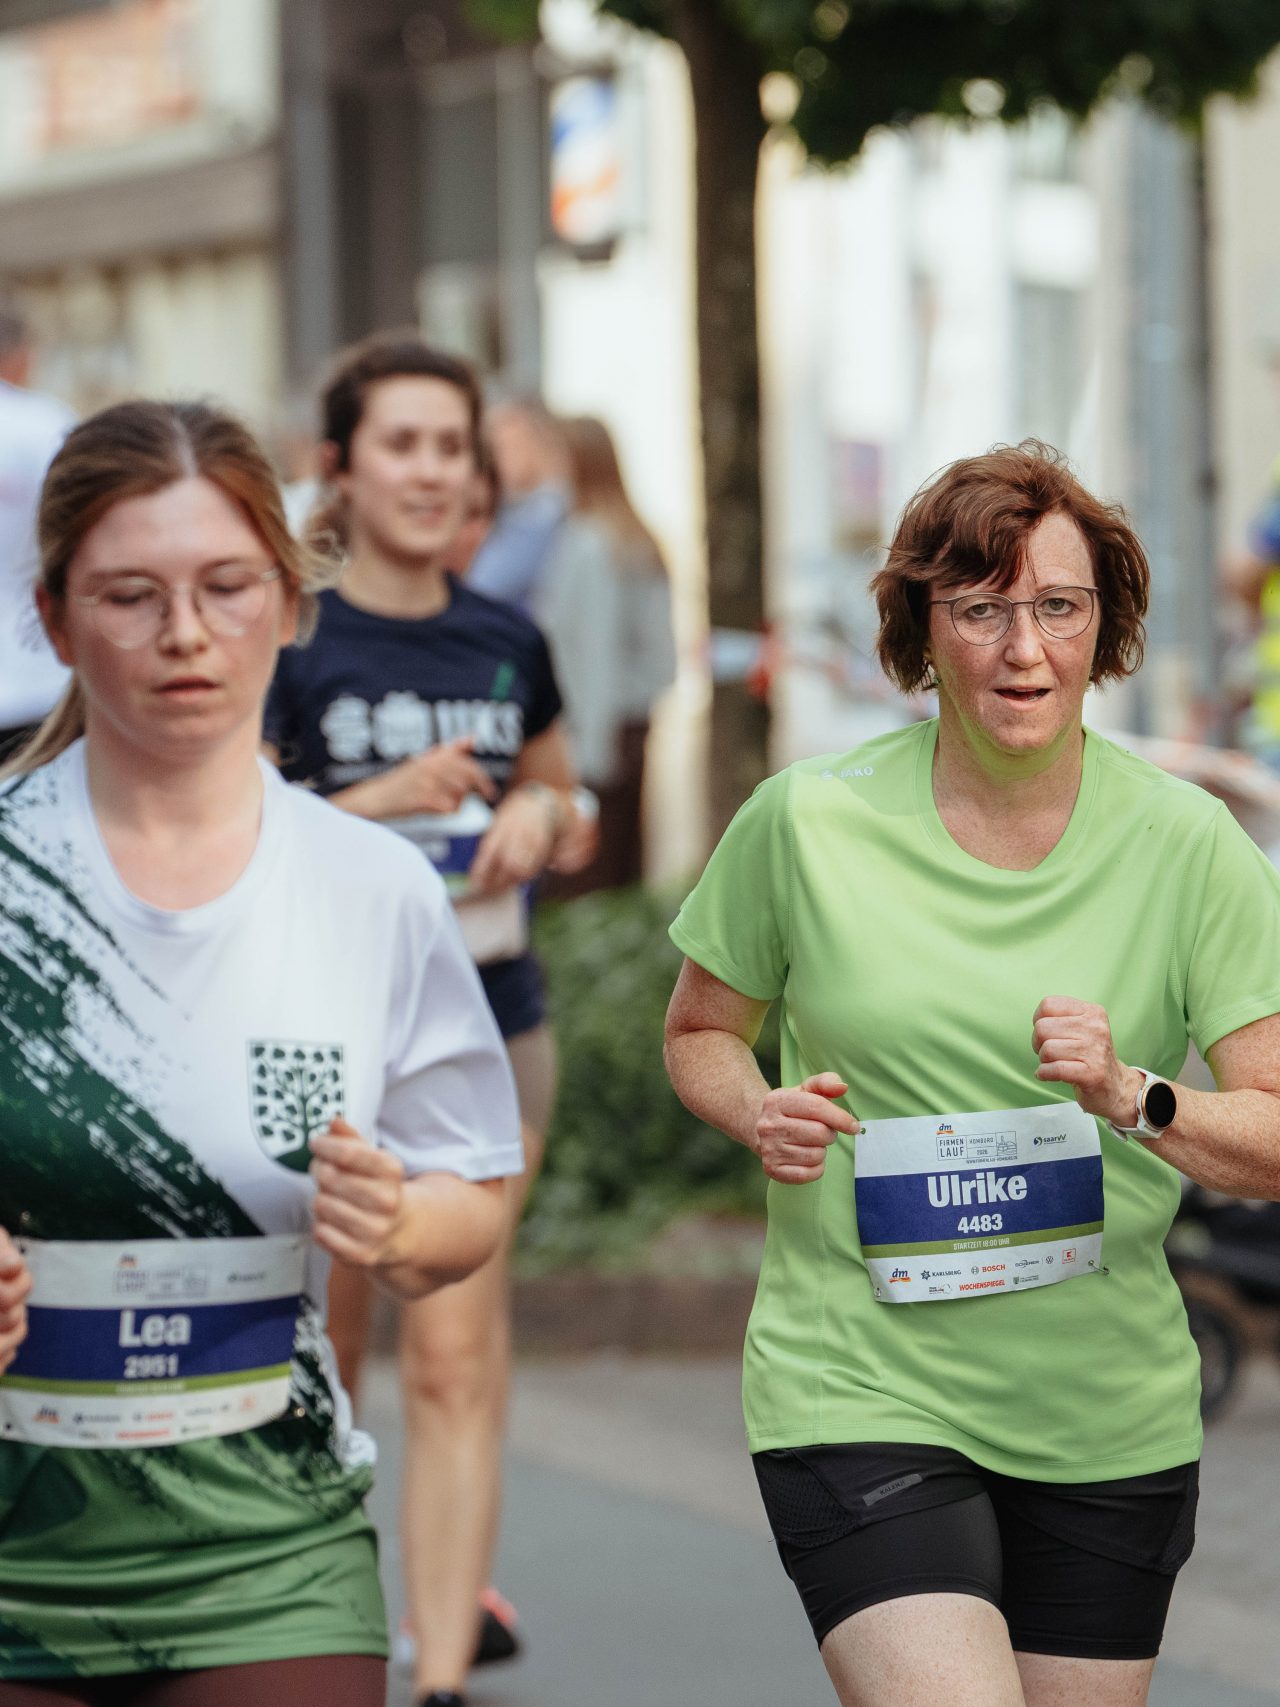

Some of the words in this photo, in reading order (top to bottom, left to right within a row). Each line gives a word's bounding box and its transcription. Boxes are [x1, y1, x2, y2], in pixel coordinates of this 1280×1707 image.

[839, 766, 874, 778] JAKO
[939, 1123, 952, 1131] dm
[939, 1138, 964, 1147] FIRMEN
[969, 1137, 994, 1145] HOMBURG
[940, 1147, 965, 1158] LAUF
[927, 1171, 1028, 1208] Ulrike
[957, 1213, 1003, 1234] 4483
[953, 1240, 982, 1250] STARTZEIT
[998, 1237, 1010, 1246] UHR
[891, 1268, 908, 1278] dm
[932, 1269, 961, 1277] KARLSBERG
[982, 1264, 1006, 1273] BOSCH
[959, 1279, 1006, 1291] WOCHENSPIEGEL
[118, 1309, 191, 1347] Lea
